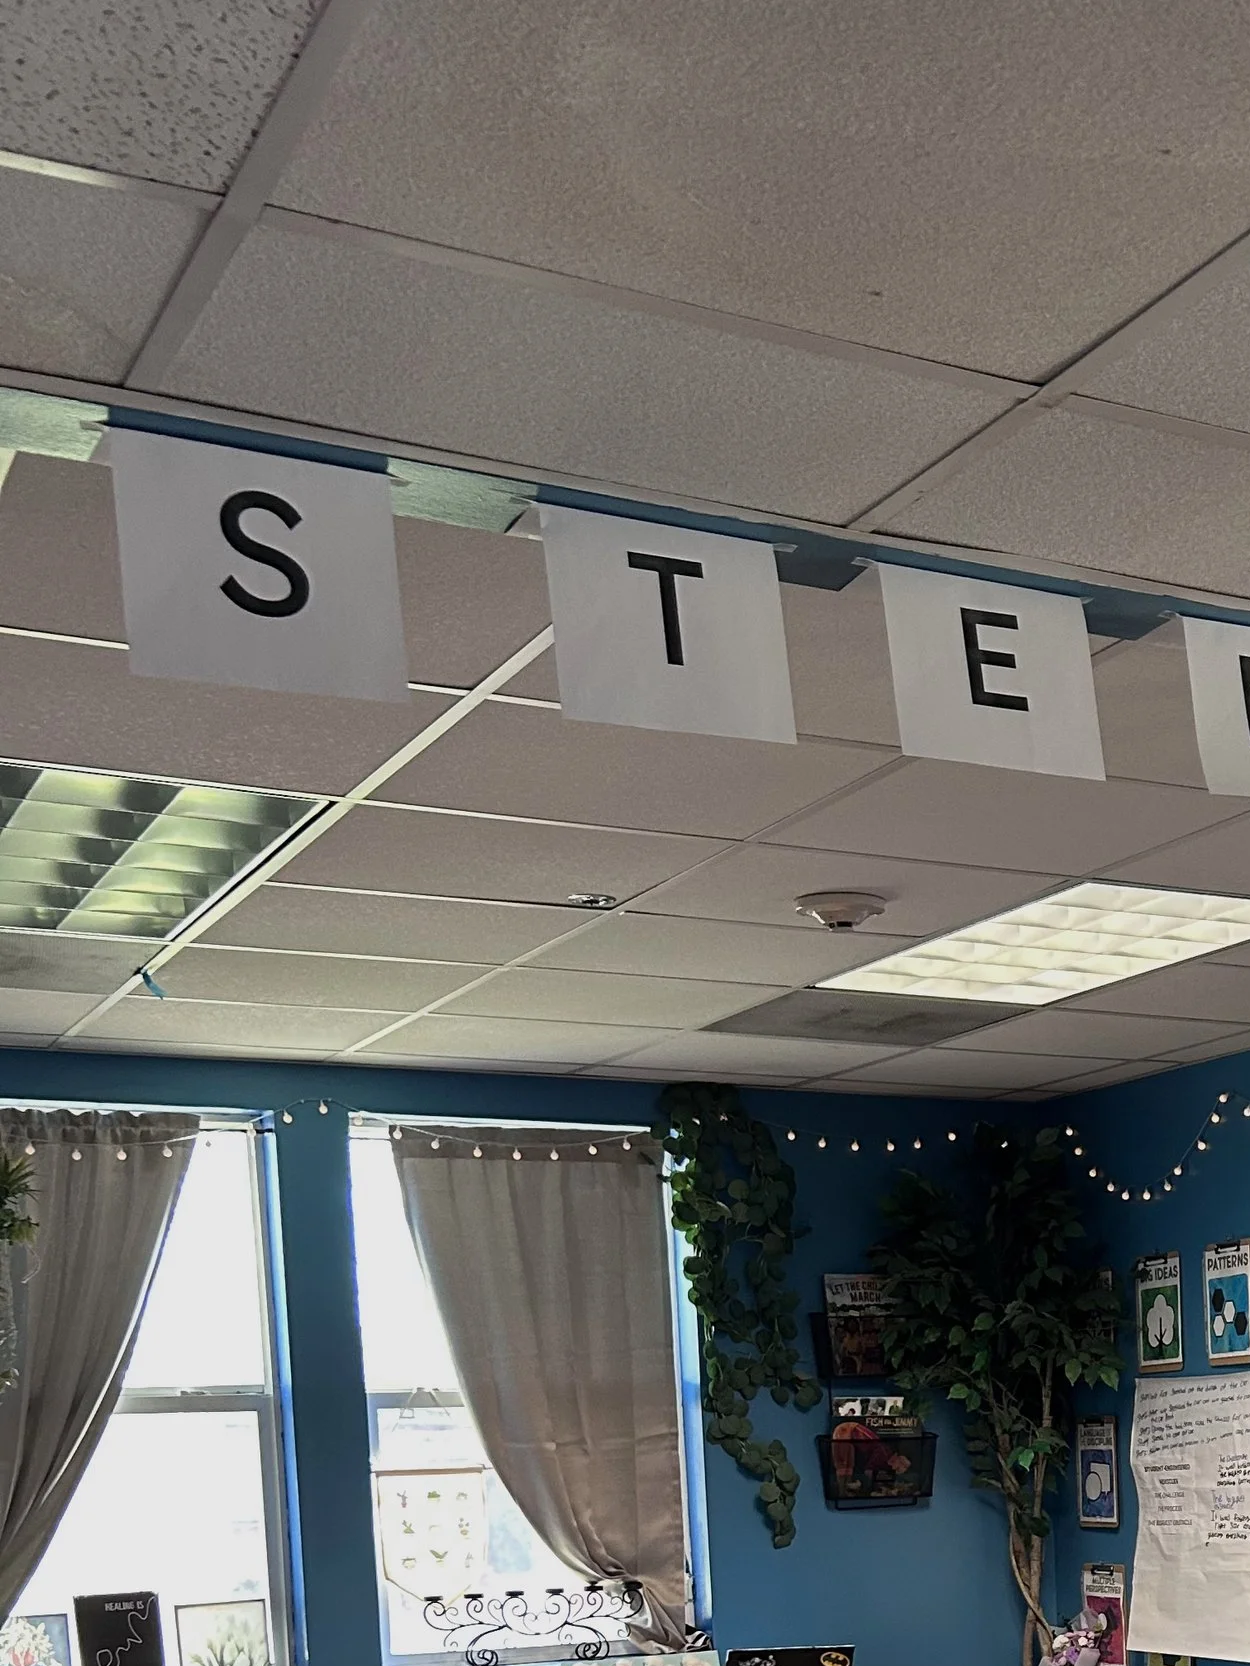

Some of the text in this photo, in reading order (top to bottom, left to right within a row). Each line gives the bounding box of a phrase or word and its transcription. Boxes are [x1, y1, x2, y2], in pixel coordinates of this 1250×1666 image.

[1206, 1252, 1249, 1272] PATTERNS
[1154, 1264, 1179, 1281] IDEAS
[829, 1283, 845, 1296] LET
[845, 1280, 861, 1291] THE
[850, 1292, 881, 1303] MARCH
[865, 1417, 884, 1427] FISH
[104, 1600, 145, 1612] HEALING IS
